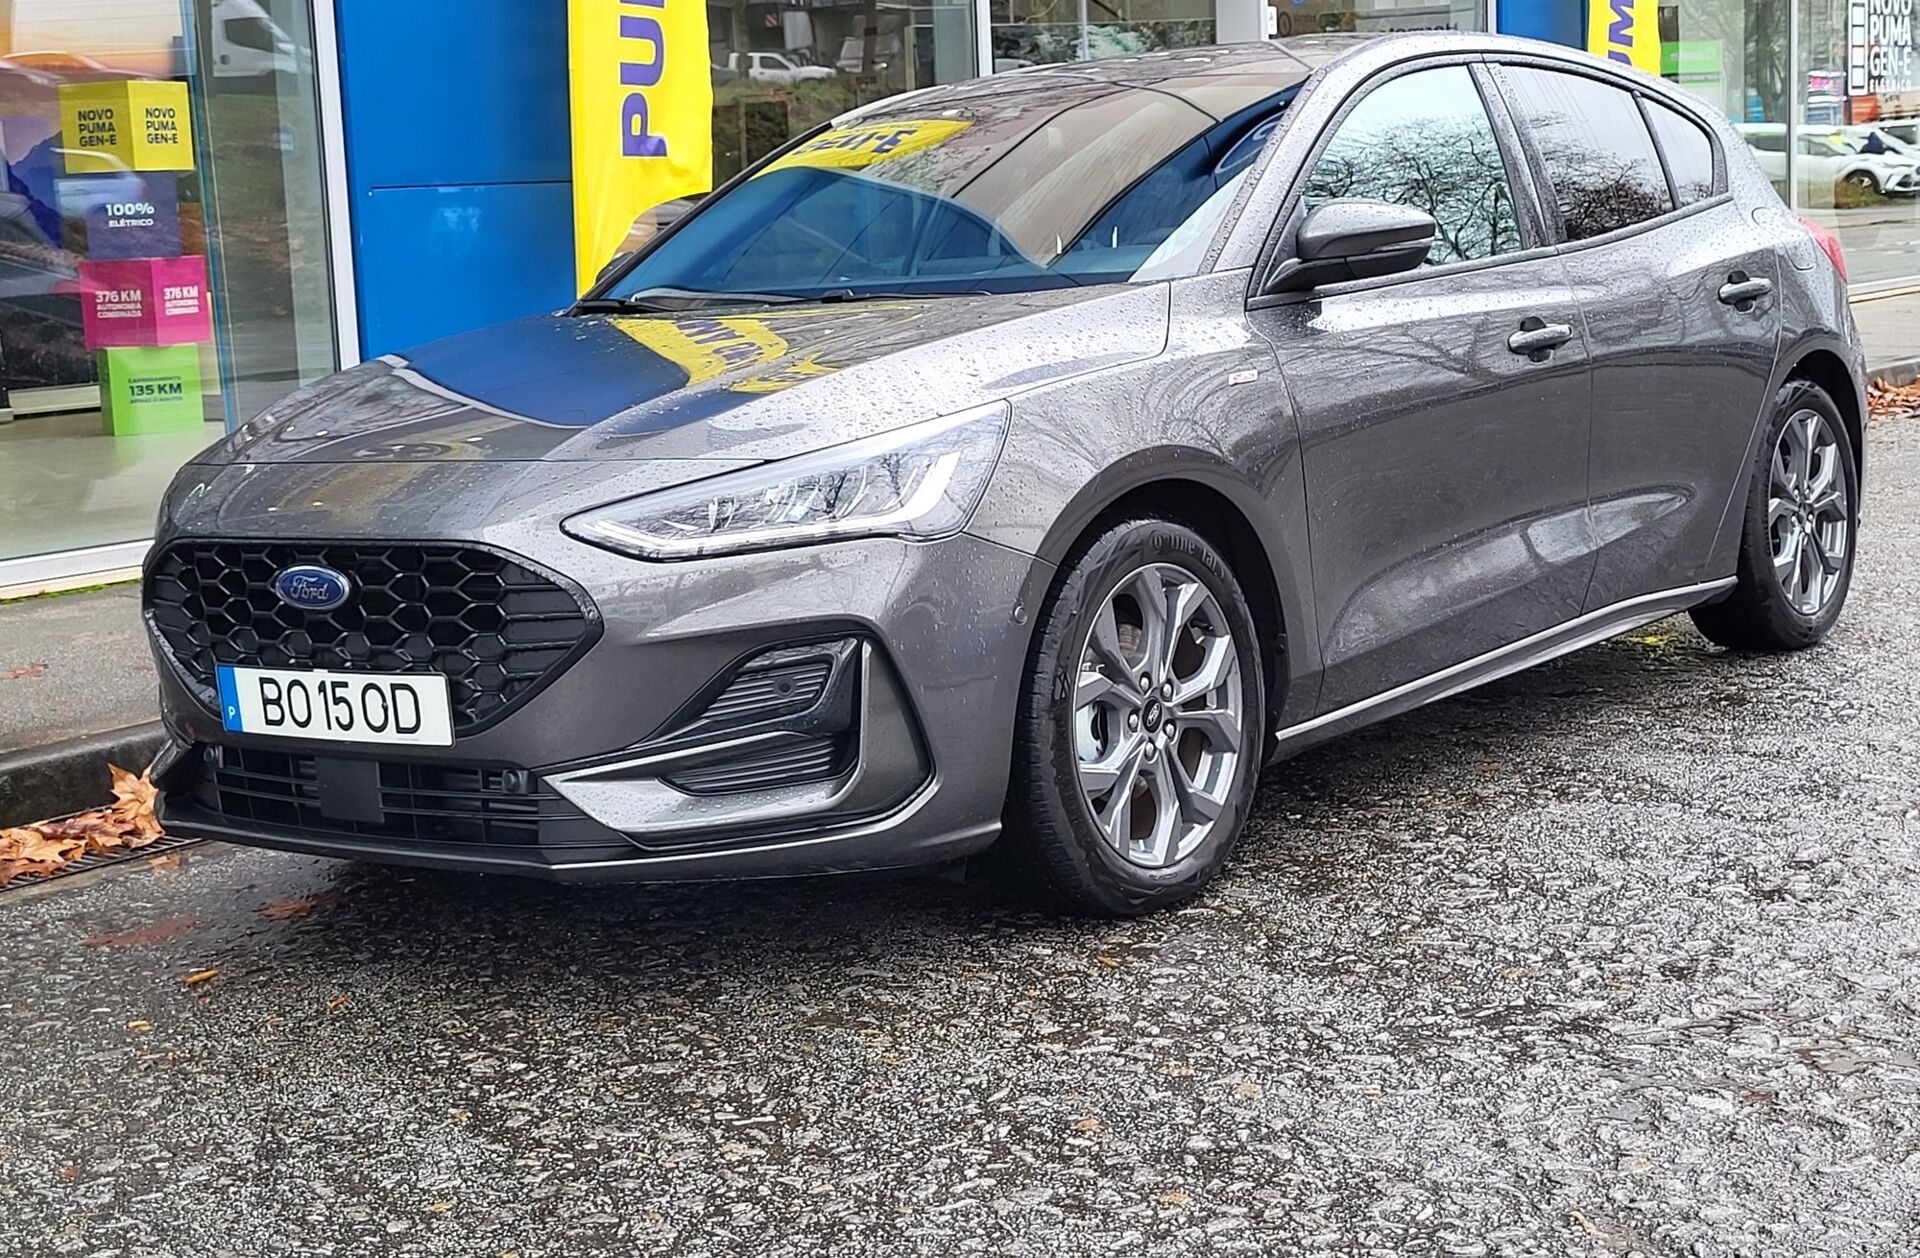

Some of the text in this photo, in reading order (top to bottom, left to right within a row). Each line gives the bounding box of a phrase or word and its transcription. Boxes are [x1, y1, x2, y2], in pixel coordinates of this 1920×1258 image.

[1869, 15, 1912, 46] PUMA
[1869, 46, 1912, 76] GEN-E
[78, 109, 114, 121] NOVO
[145, 108, 175, 119] NOVO
[78, 122, 116, 134] PUMA
[146, 121, 177, 131] PUMA
[79, 134, 117, 147] GEN-E
[147, 133, 178, 144] GEN-E
[106, 202, 155, 216] 100%
[95, 289, 142, 303] 376 KM
[163, 285, 199, 300] 376 KM
[129, 383, 183, 396] 135 KM
[290, 575, 328, 600] Ford
[228, 706, 236, 720] P
